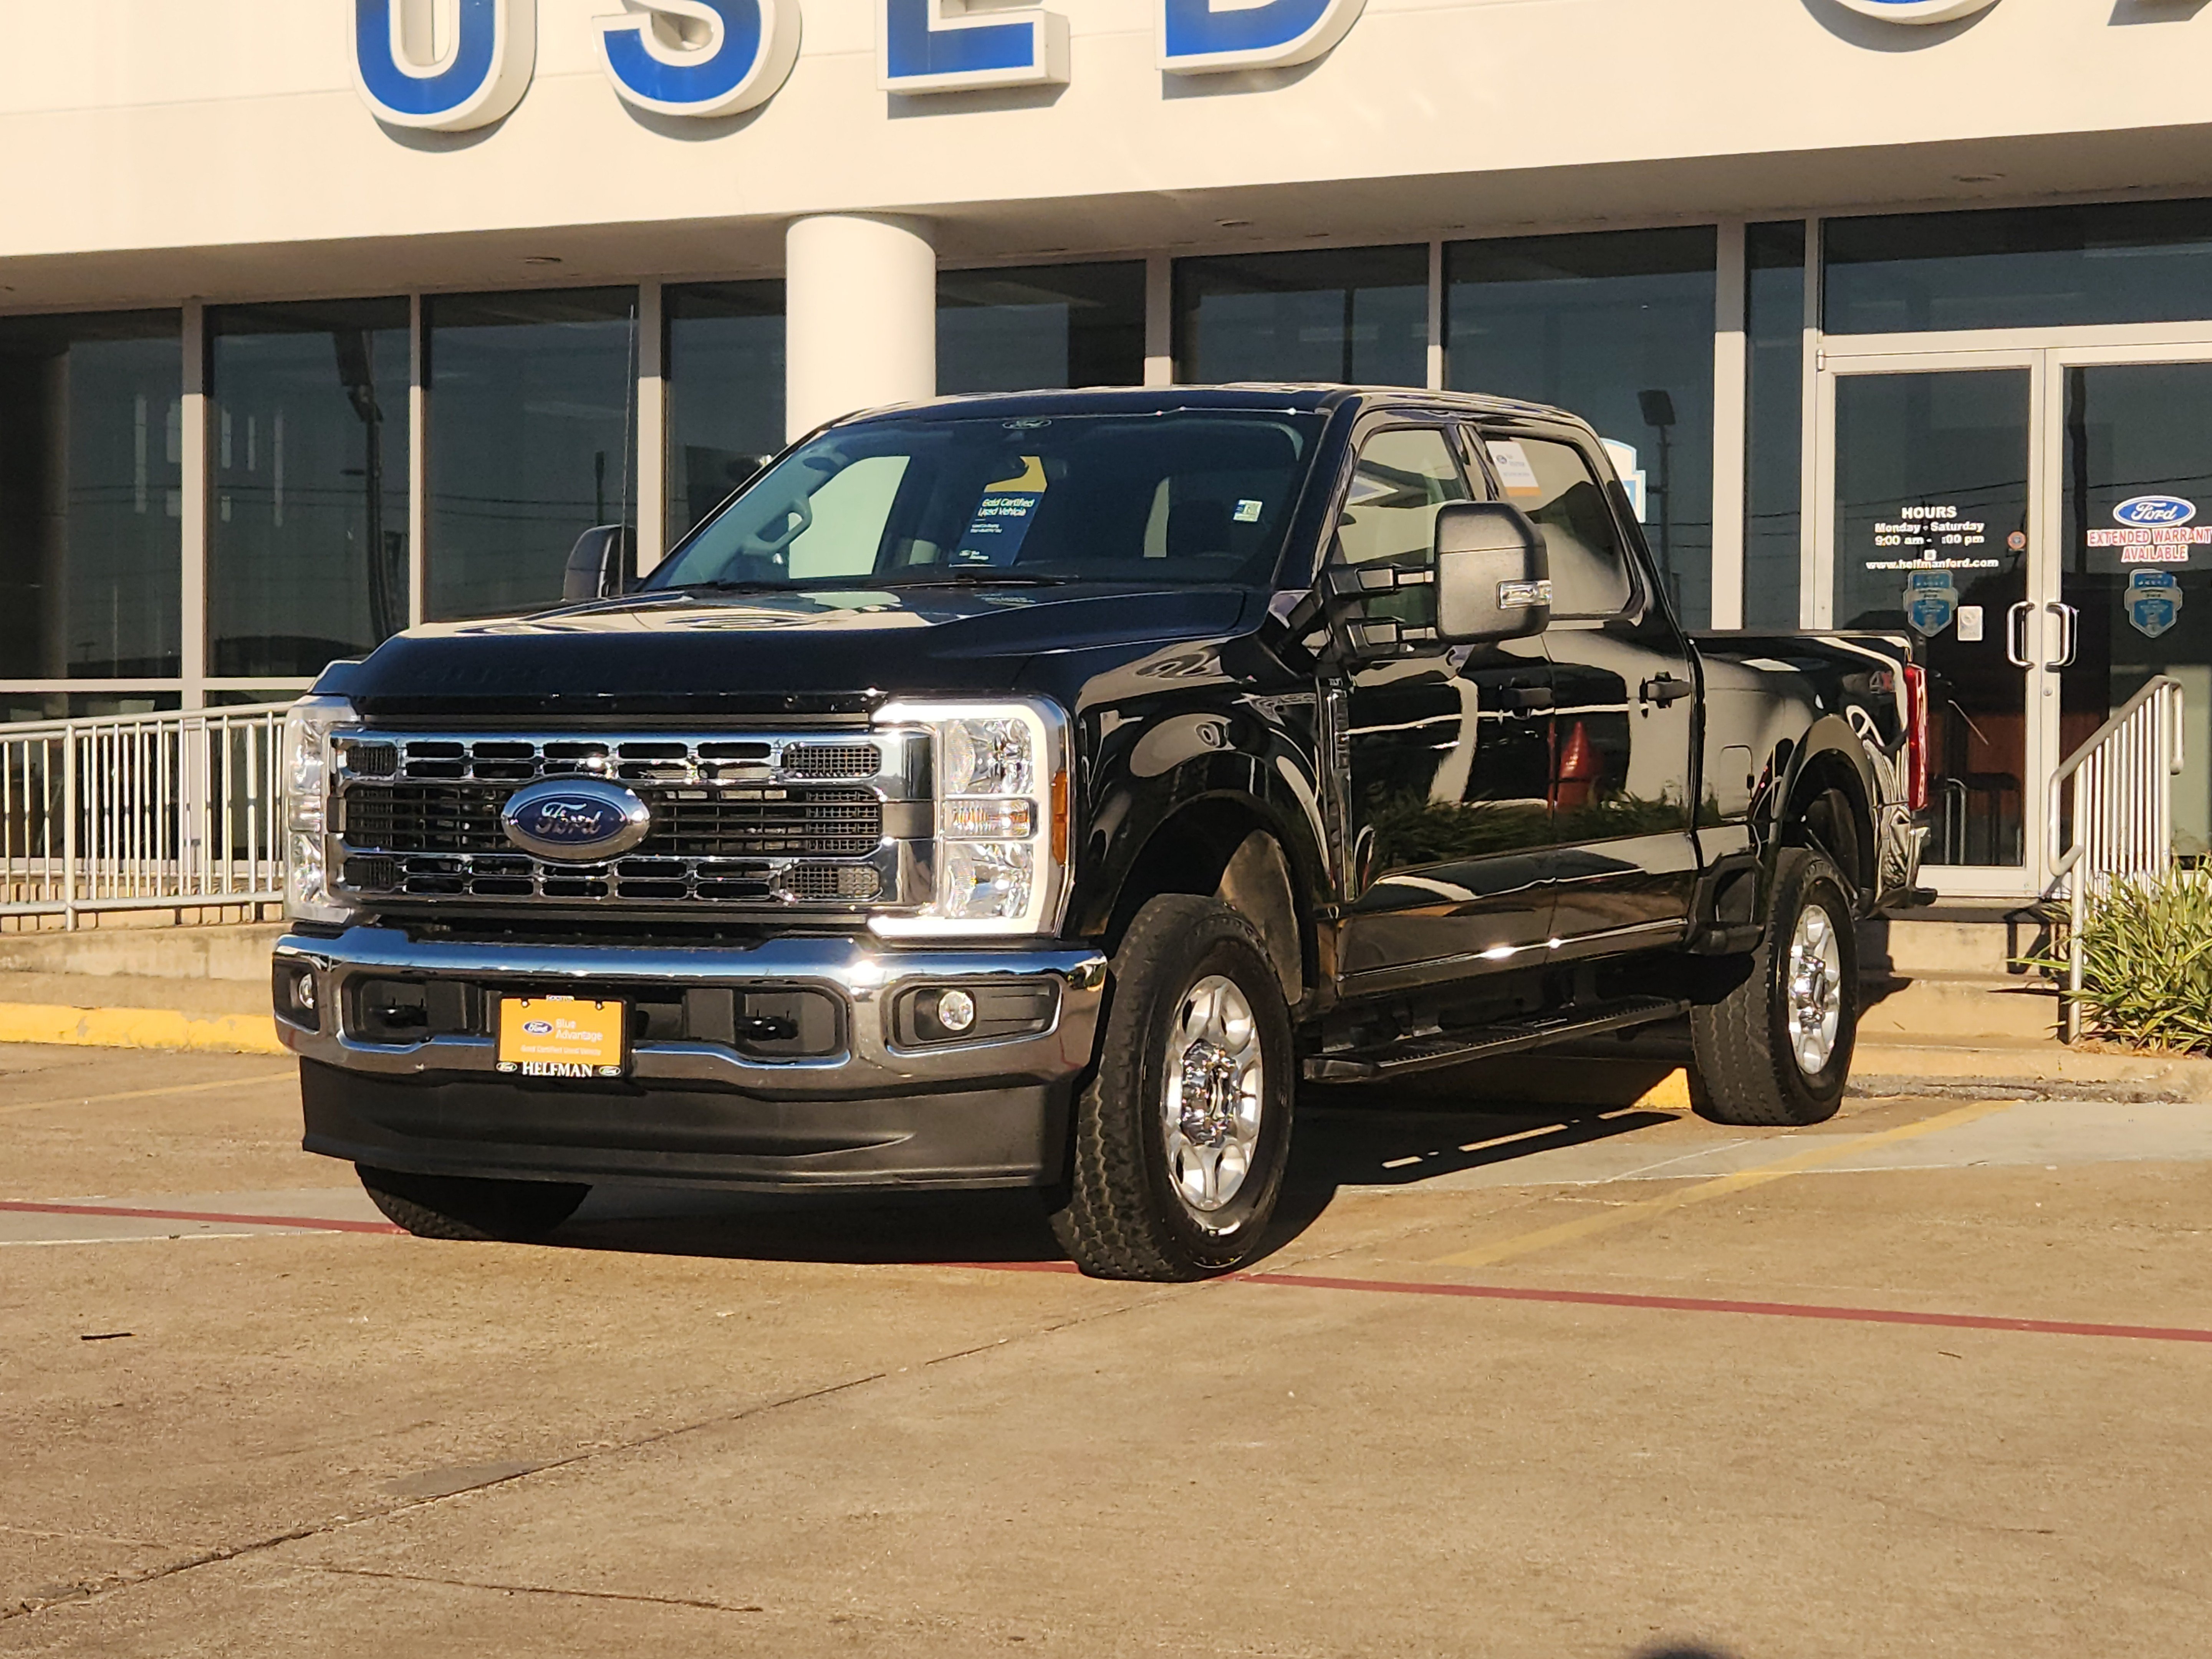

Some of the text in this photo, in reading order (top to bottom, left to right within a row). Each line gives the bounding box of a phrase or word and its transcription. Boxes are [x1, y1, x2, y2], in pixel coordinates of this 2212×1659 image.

[1902, 506, 1957, 519] HOURS
[1874, 522, 1921, 534] Monday
[1931, 521, 1985, 533] Saturday
[1964, 535, 1985, 546] pm
[2088, 530, 2150, 545] EXTENDED
[2123, 546, 2187, 561] AVAILABLE
[1866, 558, 1999, 570] www.helfmanford.com
[535, 801, 604, 835] Ford
[556, 1018, 576, 1029] Blue
[556, 1030, 603, 1042] Advantage
[522, 1061, 593, 1078] HELFMAN
